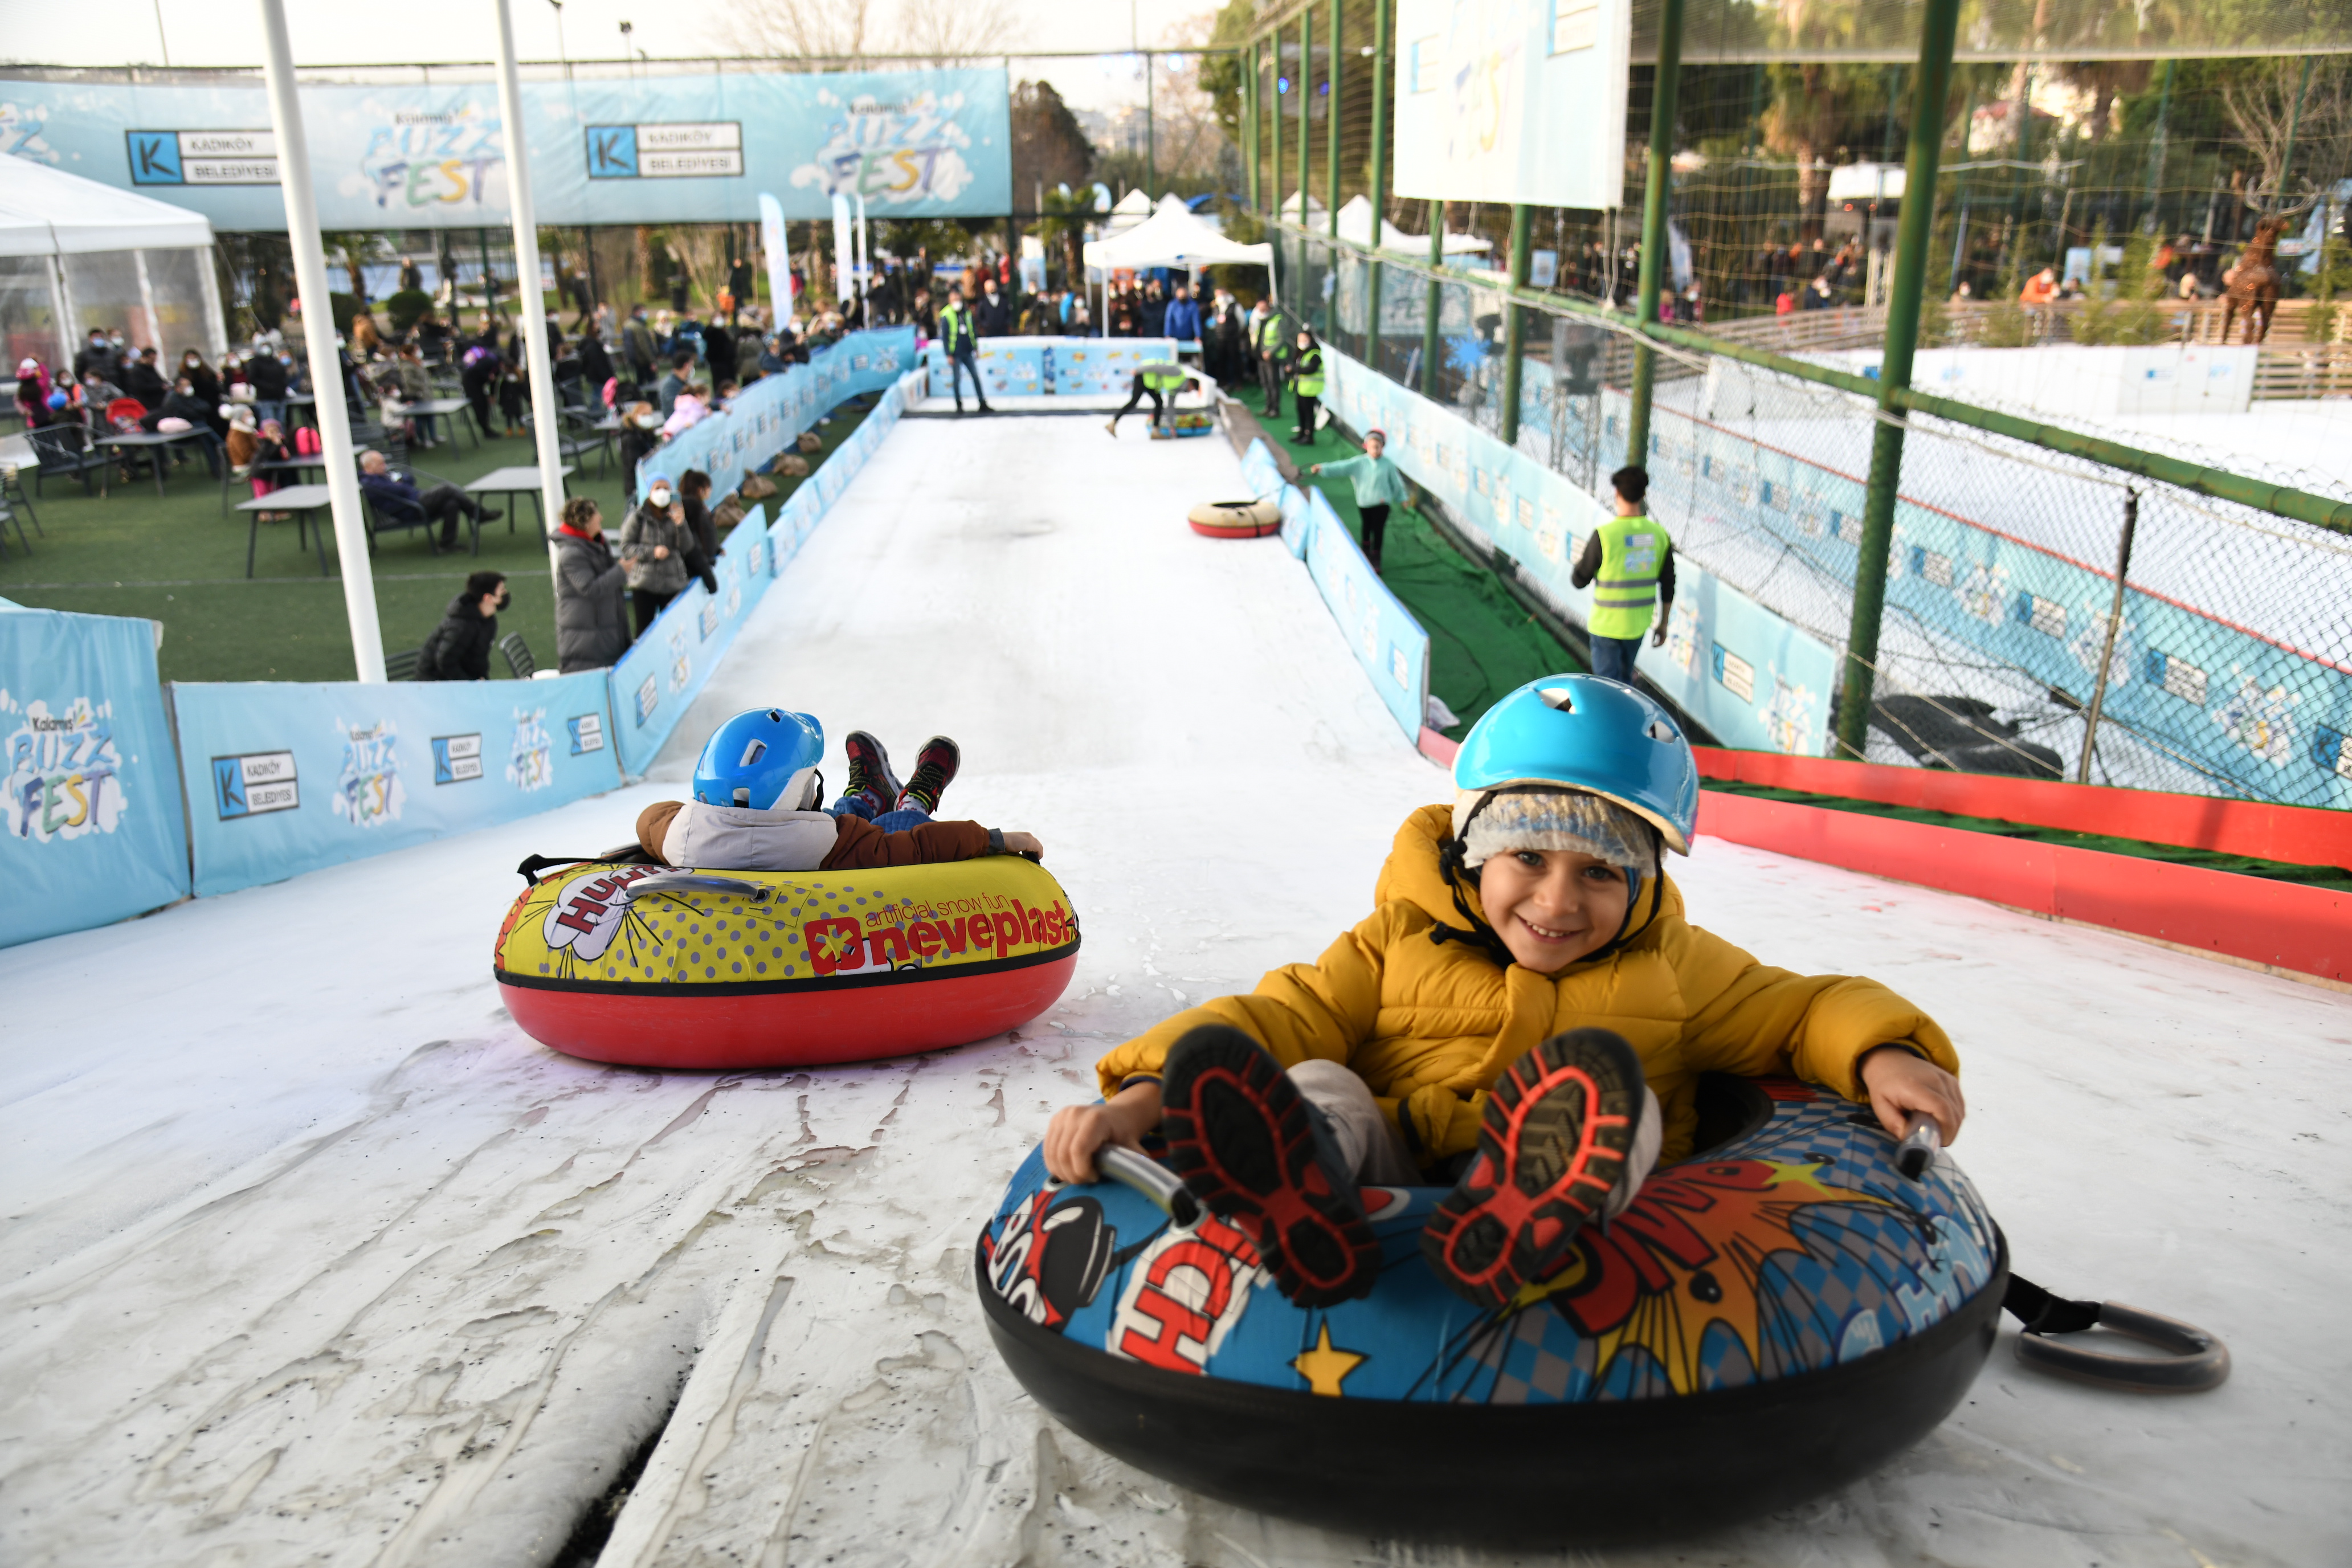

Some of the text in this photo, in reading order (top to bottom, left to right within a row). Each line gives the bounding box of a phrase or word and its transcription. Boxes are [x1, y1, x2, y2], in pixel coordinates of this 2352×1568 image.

[140, 138, 177, 175] K
[190, 136, 255, 152] KADIKÖY
[378, 157, 503, 208] FEST
[828, 148, 952, 197] FEST
[247, 759, 281, 777] KADIKÖY
[21, 769, 112, 837] FEST
[346, 771, 395, 823] FEST
[865, 892, 1010, 927] artificial snow fun
[867, 899, 1071, 966] neveplast
